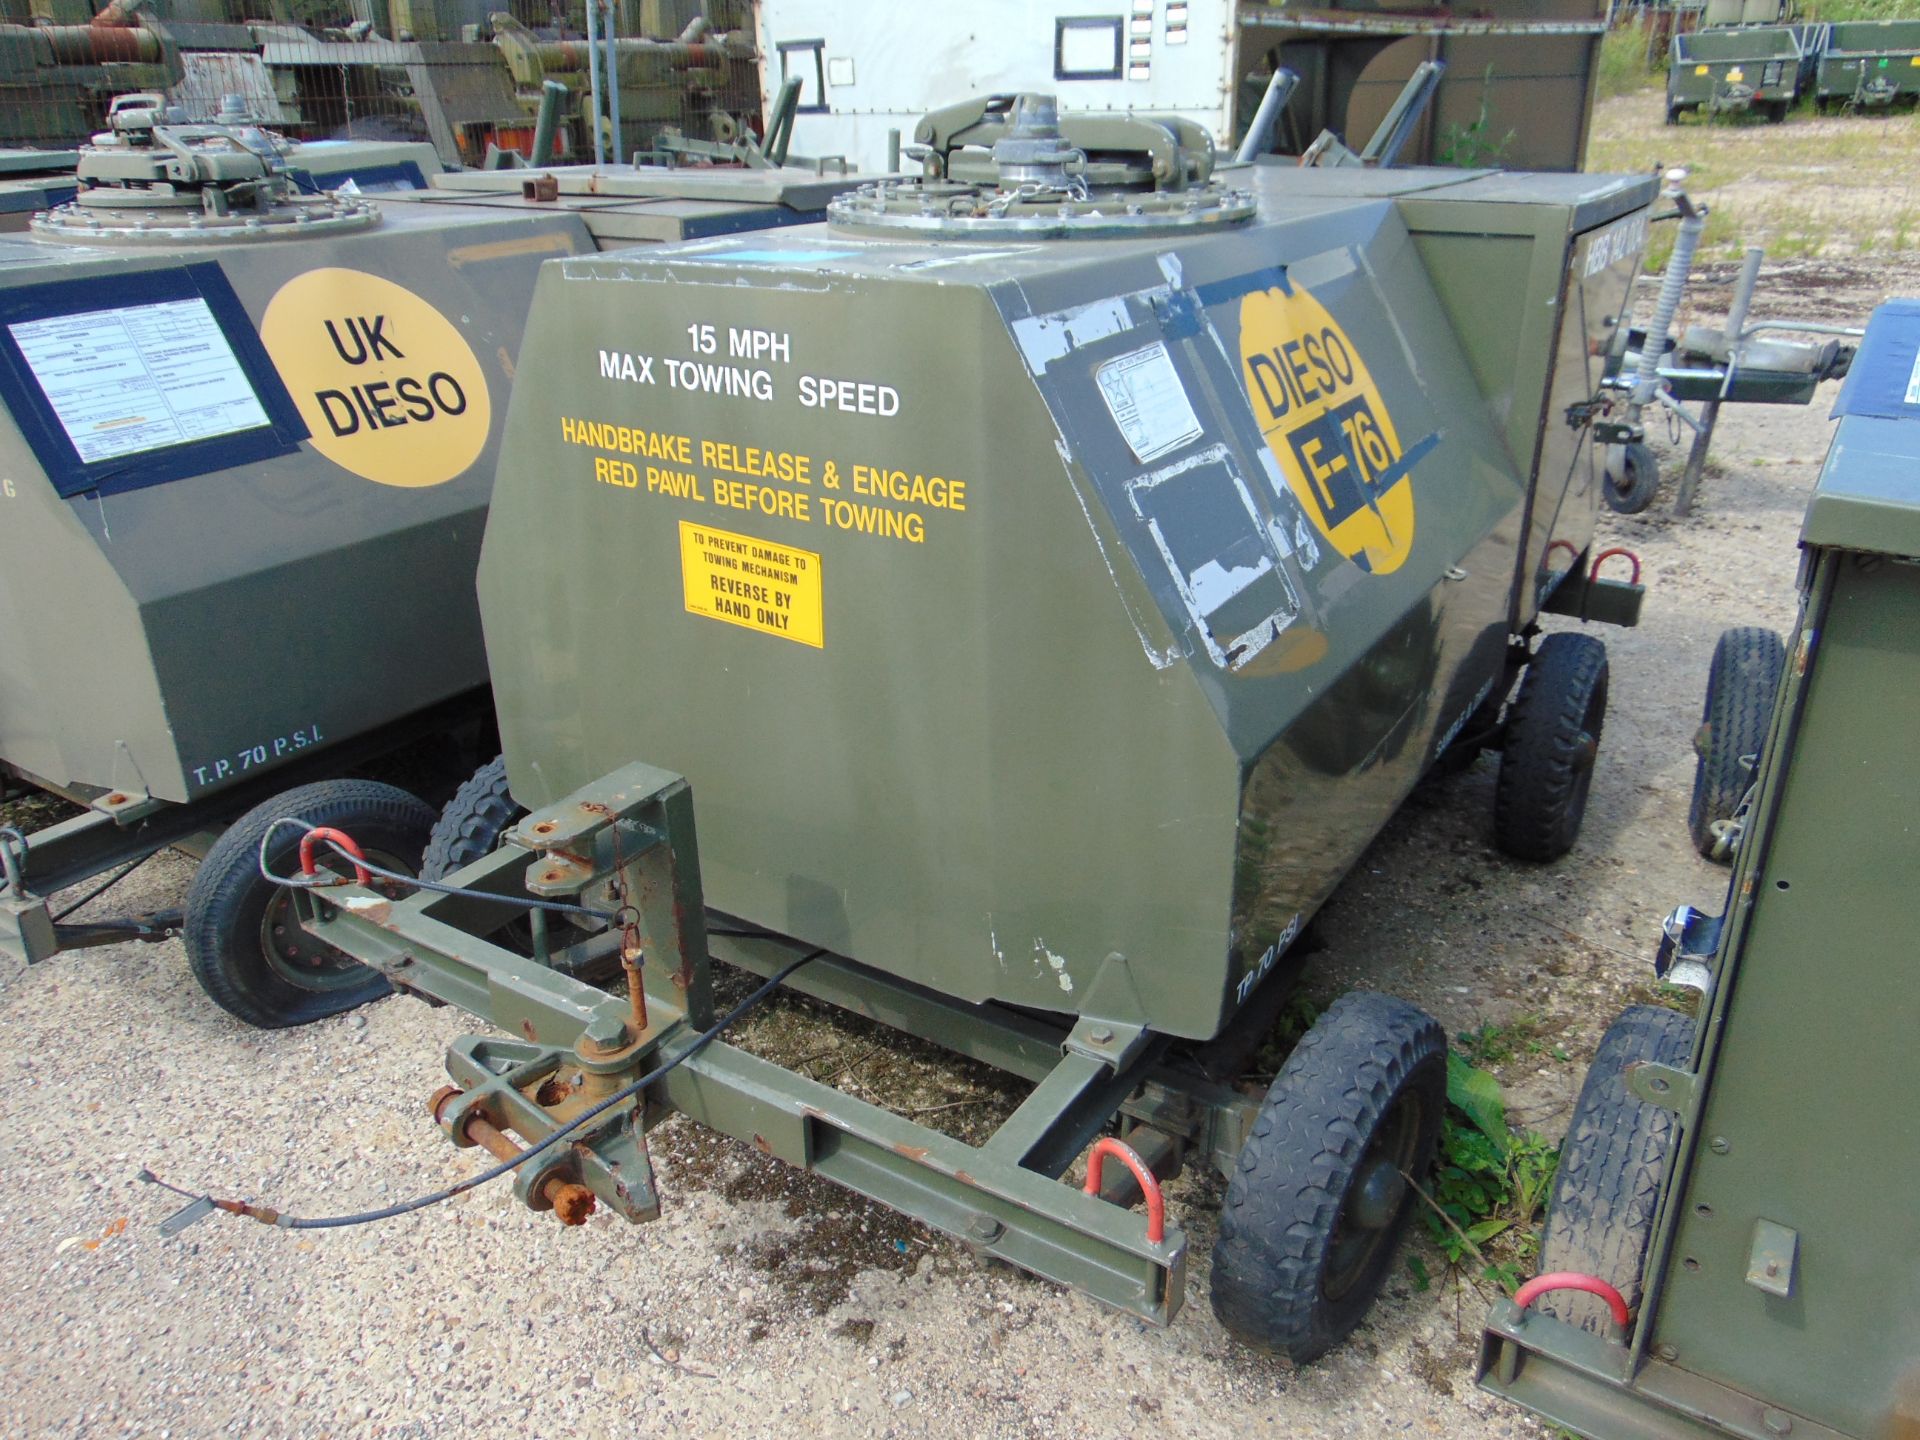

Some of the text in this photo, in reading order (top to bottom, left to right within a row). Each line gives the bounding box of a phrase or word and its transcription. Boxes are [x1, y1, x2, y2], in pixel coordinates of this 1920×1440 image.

[324, 315, 406, 366] UK
[687, 323, 790, 363] 15 MPH
[599, 350, 900, 417] MAX TOWING SPEED
[1246, 327, 1354, 420] DIESO
[314, 371, 467, 438] DIESO
[561, 416, 967, 512] HANDBRAKE RELEASE & ENGAGE
[1301, 411, 1389, 510] F-76
[594, 457, 926, 544] RED PAWL BEFORE TOWING
[693, 532, 807, 571] TO PREVENT DAMAGE TO
[703, 551, 799, 586] TOWING MECHANISM
[710, 574, 791, 610] REVERSE BY
[715, 596, 789, 630] HAND ONLY
[193, 724, 323, 786] T.P. 70 P.S.I.
[1236, 969, 1254, 1005] TP
[1256, 944, 1275, 980] 70
